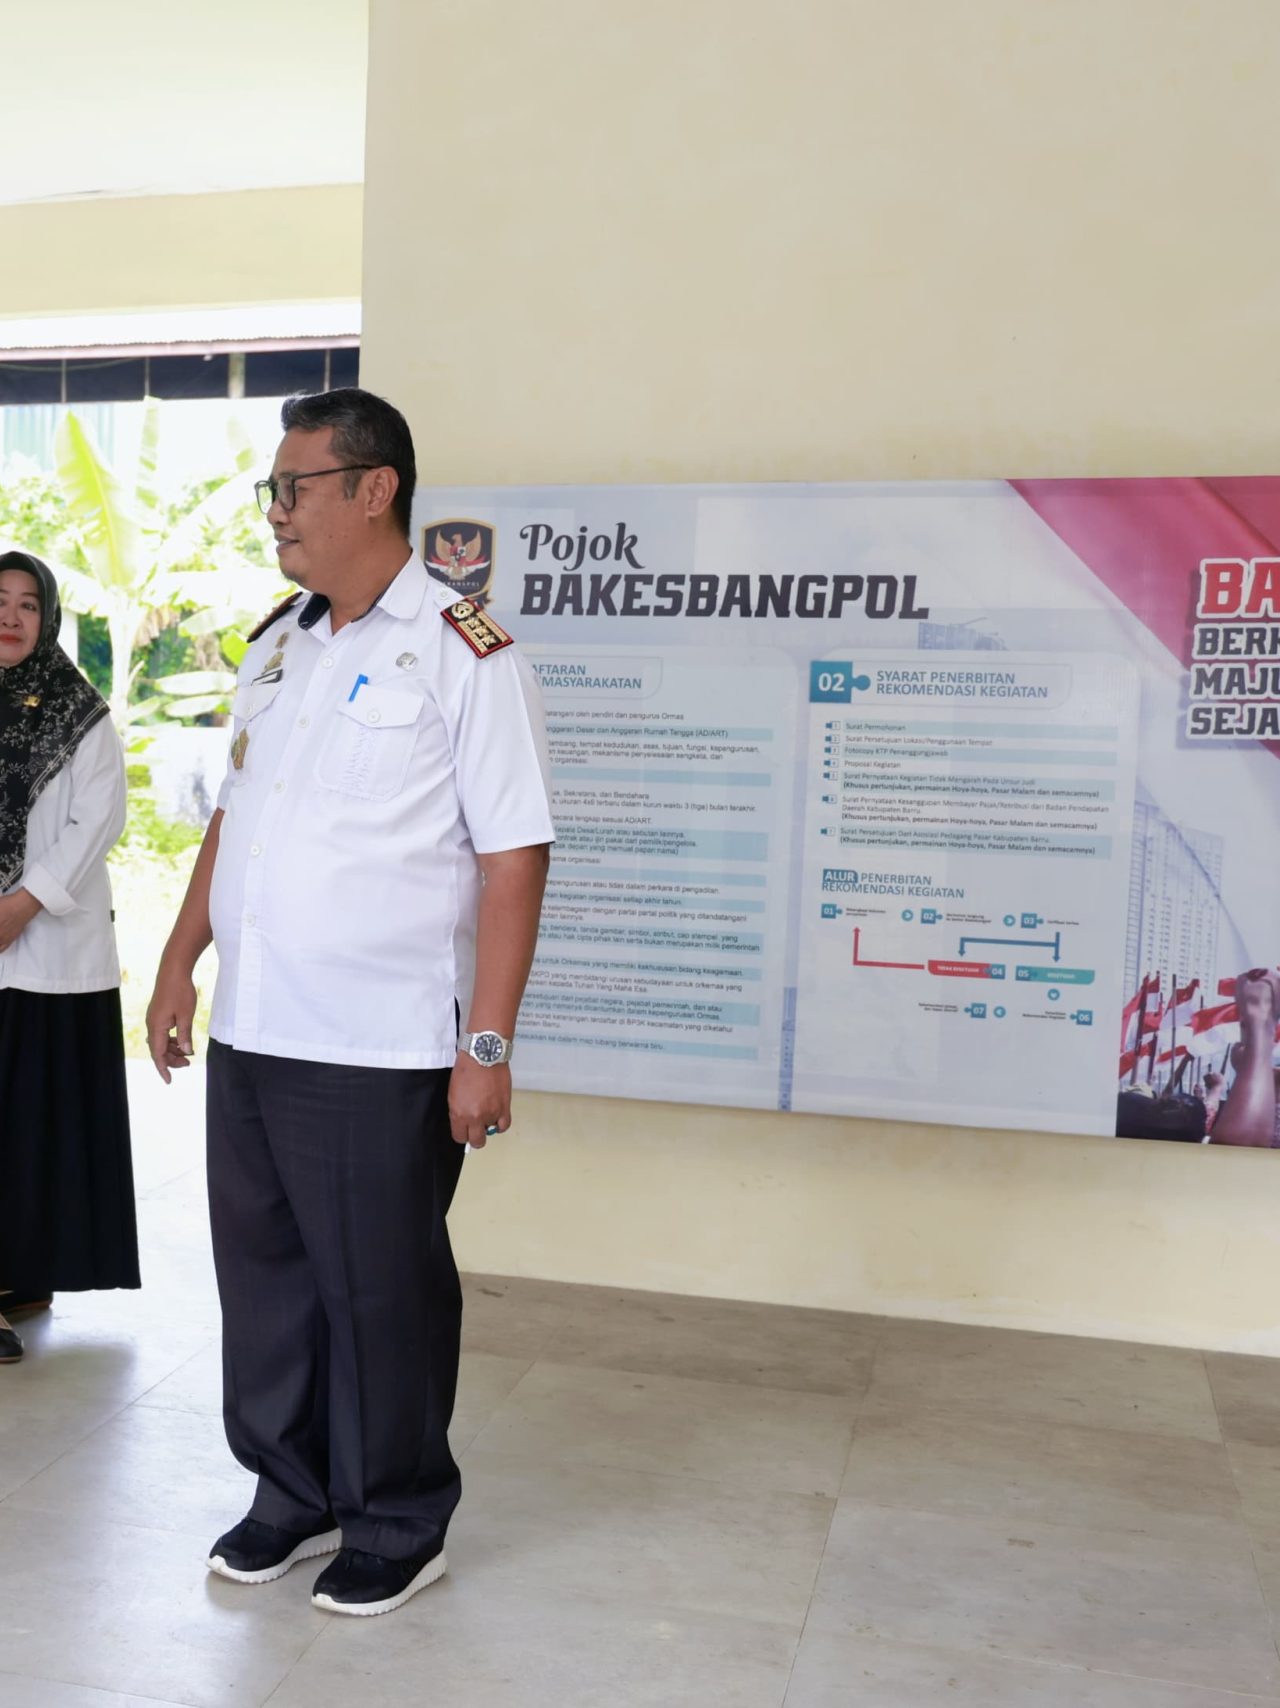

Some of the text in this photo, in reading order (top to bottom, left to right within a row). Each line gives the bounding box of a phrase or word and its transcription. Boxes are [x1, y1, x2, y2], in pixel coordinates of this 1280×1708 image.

[519, 522, 645, 571] Pojok
[1200, 560, 1280, 616] BA
[520, 574, 929, 619] BAKESBANGPOL
[538, 676, 641, 689] MASYARAKATAN
[818, 672, 845, 691] 02
[877, 671, 1015, 683] SYARAT PENERBITAN
[877, 684, 1048, 698] REKOMENDASI KEGIATAN
[825, 872, 932, 885] ALUR PENERBITAN
[822, 883, 964, 898] REKOMENDASI KEGIATAN
[923, 912, 933, 920] 02
